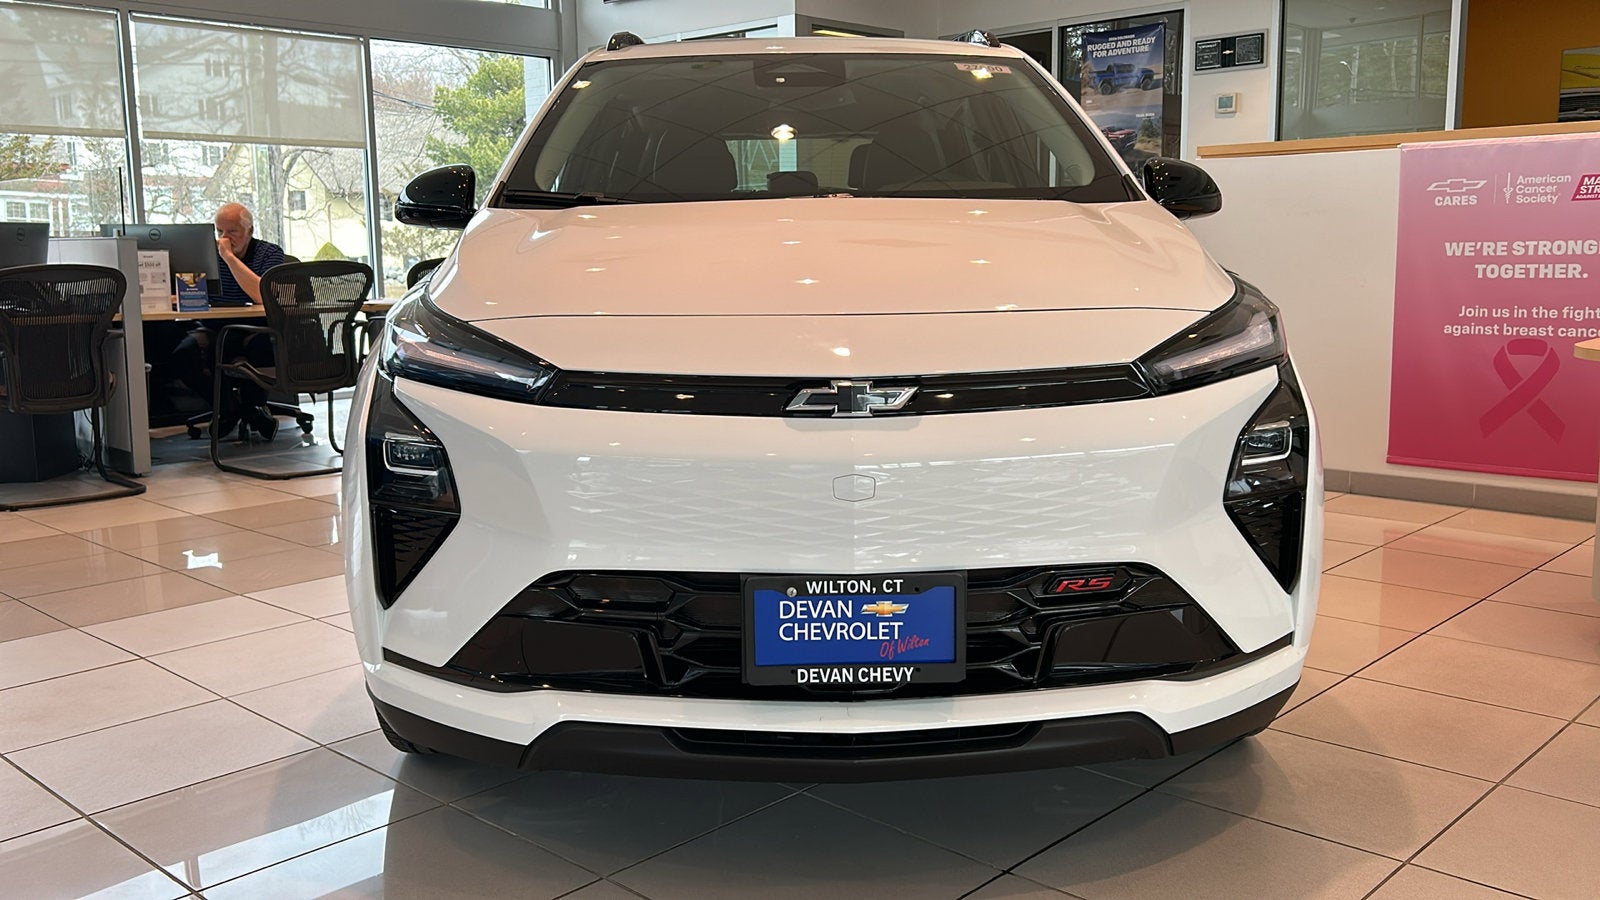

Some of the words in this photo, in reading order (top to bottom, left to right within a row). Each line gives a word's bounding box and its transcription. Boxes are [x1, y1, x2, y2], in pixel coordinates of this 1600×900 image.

[1087, 41, 1116, 52] RUGGED
[1117, 40, 1132, 48] AND
[1133, 36, 1156, 46] READY
[1093, 50, 1107, 58] FOR
[1108, 45, 1150, 56] ADVENTURE
[1516, 174, 1572, 185] American
[1516, 185, 1558, 194] Cancer
[1434, 195, 1478, 206] CARES
[1516, 193, 1558, 205] Society
[1444, 241, 1508, 256] WE'RE
[1475, 264, 1589, 279] TOGETHER.
[1458, 305, 1488, 318] Join
[1492, 307, 1510, 318] us
[1513, 306, 1527, 319] in
[1531, 306, 1558, 319] the
[1562, 306, 1600, 322] fight
[1443, 322, 1500, 337] against
[1503, 323, 1556, 337] breast
[806, 580, 877, 595] WILTON,
[882, 579, 904, 594] CT
[1055, 577, 1113, 593] RS
[779, 600, 853, 619] DEVAN
[778, 622, 904, 641] CHEVROLET
[879, 642, 895, 660] Of
[897, 635, 930, 655] Wilton
[797, 668, 854, 684] DEVAN
[858, 667, 914, 683] CHEVY
